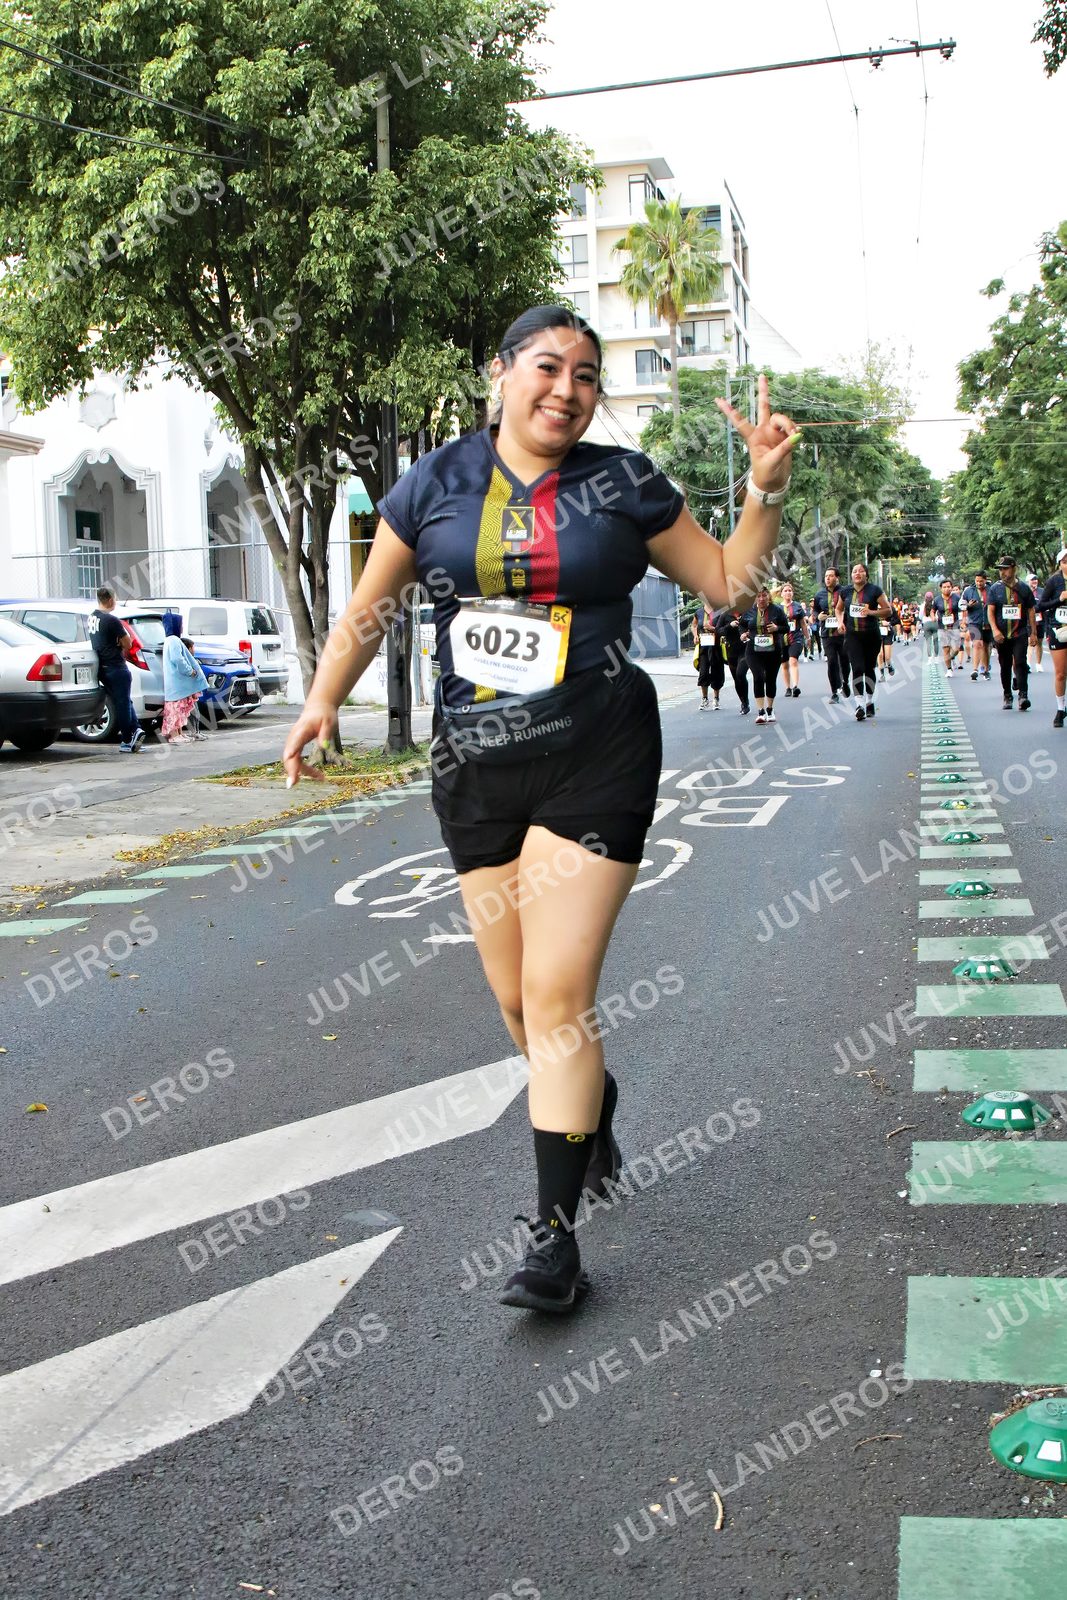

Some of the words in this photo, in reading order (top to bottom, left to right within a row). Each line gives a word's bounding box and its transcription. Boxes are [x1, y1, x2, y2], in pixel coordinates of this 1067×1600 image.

[553, 612, 568, 624] 5K
[465, 623, 541, 662] 6023
[480, 734, 511, 748] KEEP
[514, 715, 573, 743] RUNNING
